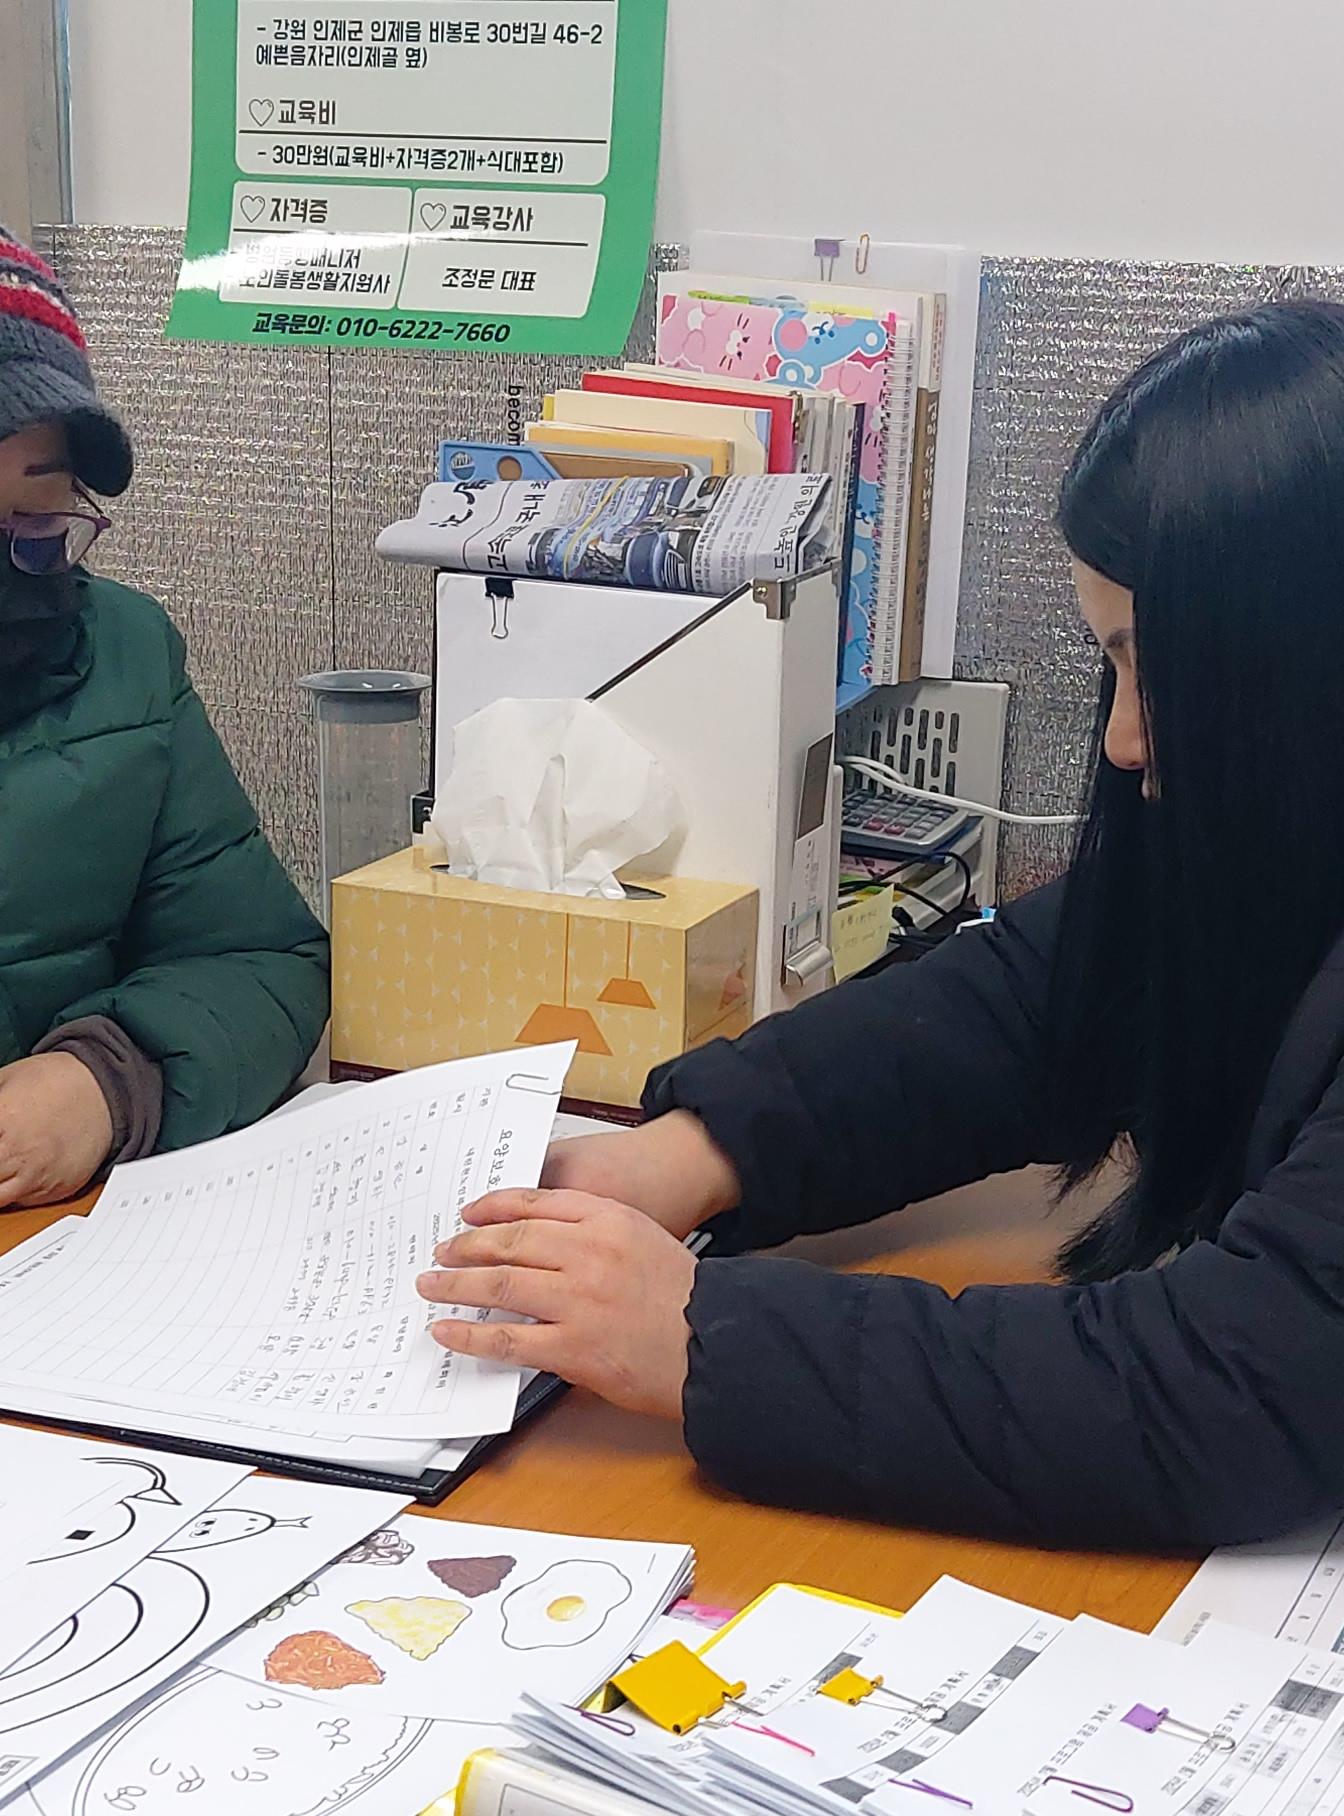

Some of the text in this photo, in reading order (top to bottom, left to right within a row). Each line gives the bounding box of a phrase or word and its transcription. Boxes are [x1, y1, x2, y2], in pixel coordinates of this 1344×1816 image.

[273, 19, 603, 45] 강원 인제군 인제읍 비봉로 30번길 46-2
[256, 45, 428, 69] 예쁜음자리(인제골 옆)
[277, 99, 337, 125] 교육비
[272, 145, 564, 174] 30만원(교육비+자격증2개+식대포함)
[269, 198, 328, 224] 자격증
[450, 204, 534, 232] 교육강사
[442, 267, 537, 292] 조정문 대표
[252, 313, 511, 343] 교육문의: 010-6222-7660
[508, 385, 524, 446] becom
